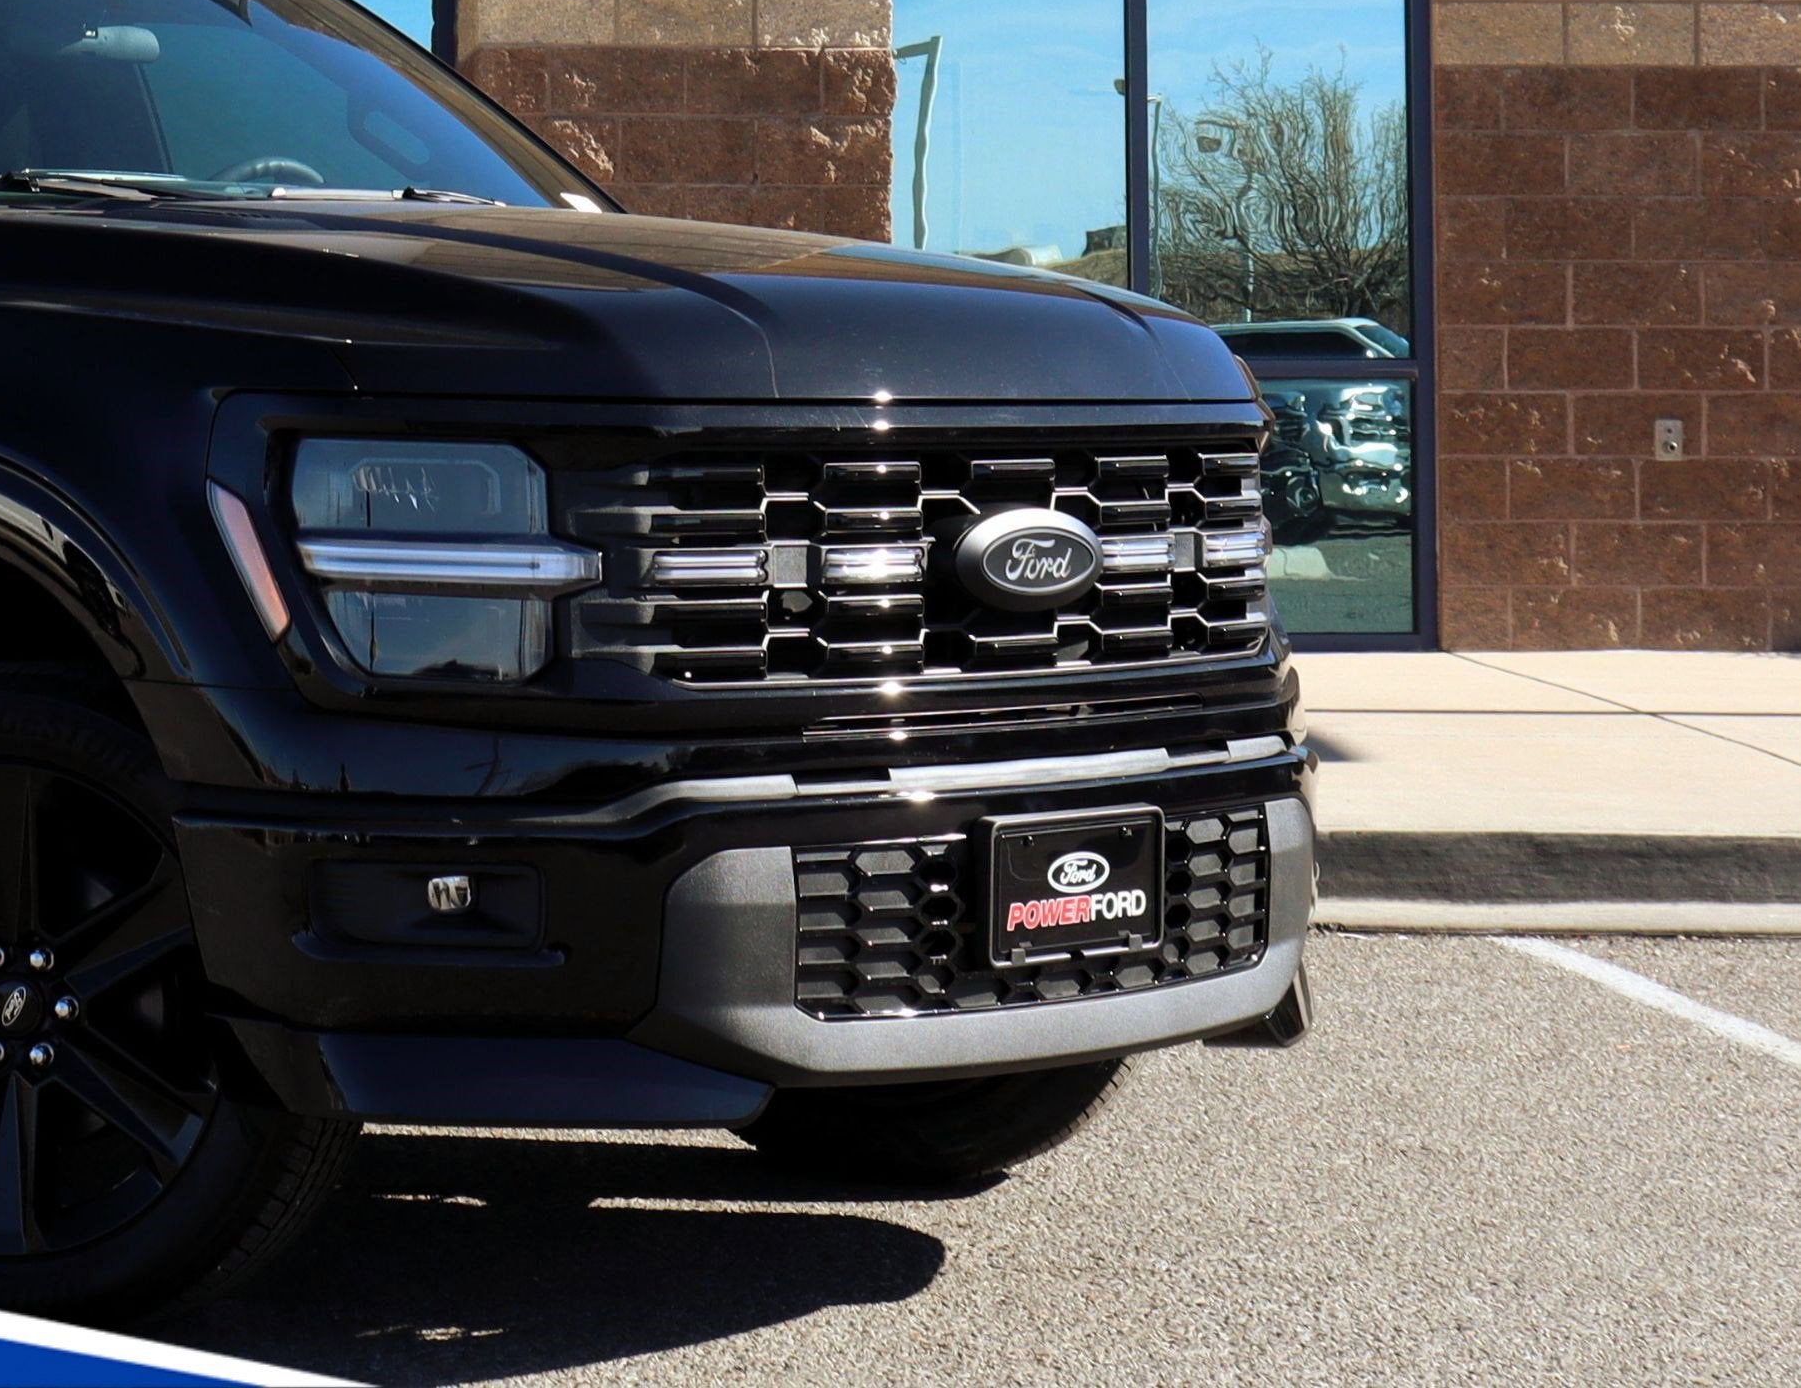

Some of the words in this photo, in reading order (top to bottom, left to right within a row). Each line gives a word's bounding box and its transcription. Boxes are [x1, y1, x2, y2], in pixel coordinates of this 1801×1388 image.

[1005, 538, 1073, 581] Ford
[1059, 859, 1096, 885] Ford
[1006, 889, 1147, 932] POWERFORD
